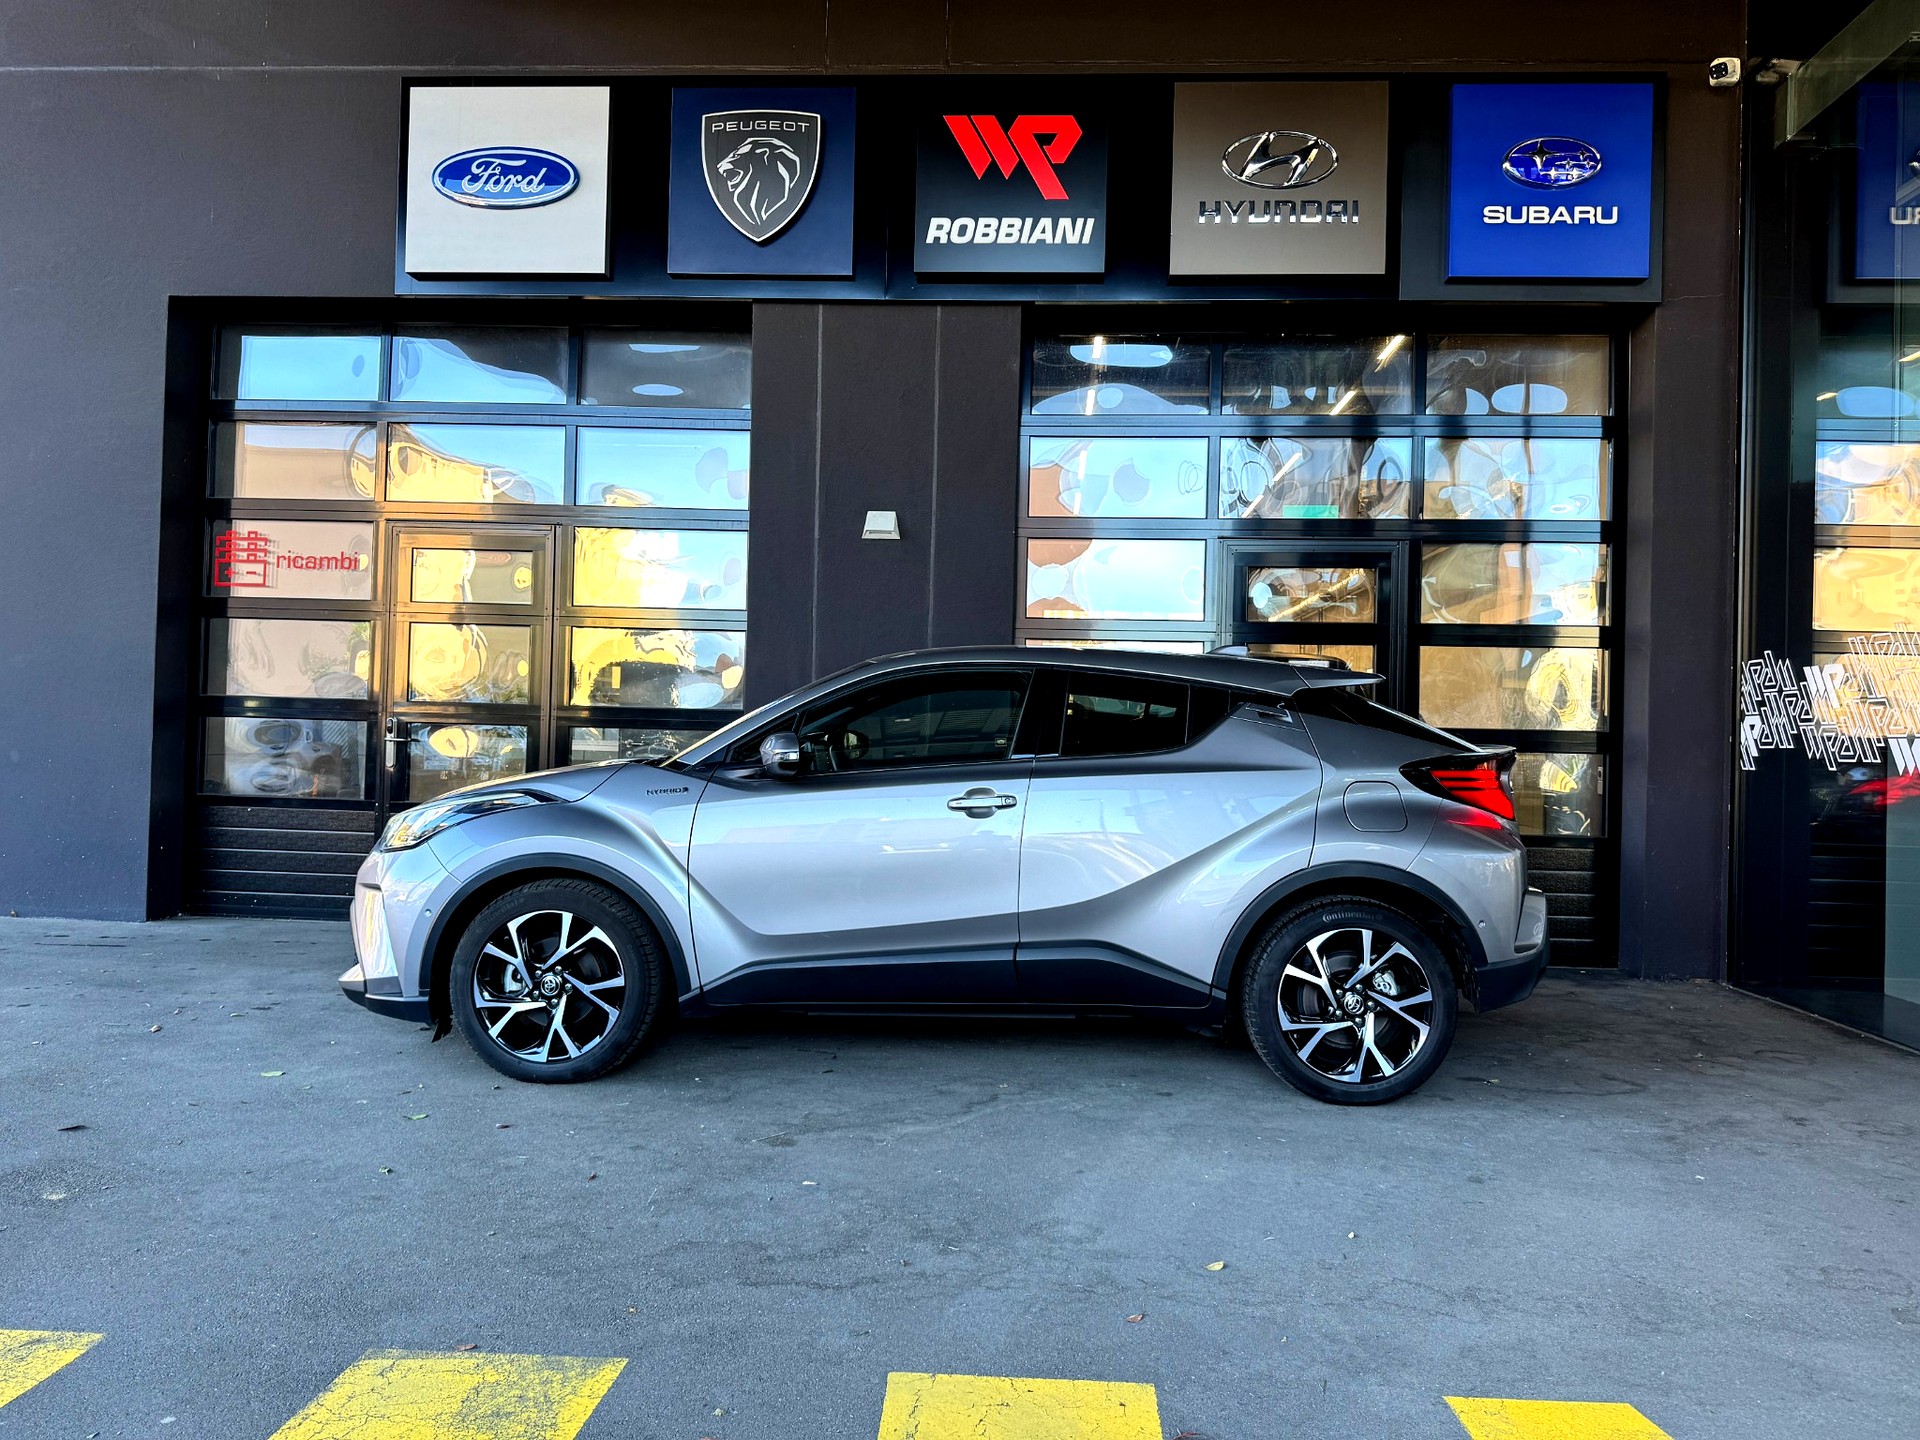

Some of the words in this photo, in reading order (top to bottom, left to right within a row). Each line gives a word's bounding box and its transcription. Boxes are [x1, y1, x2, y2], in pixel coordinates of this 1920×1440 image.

[711, 119, 811, 134] PEUGEOT
[463, 157, 546, 194] Ford
[1198, 199, 1360, 225] HYUNDAI
[1482, 205, 1619, 227] SUBARU
[926, 217, 1094, 244] ROBBIANI
[276, 550, 359, 570] ricambi
